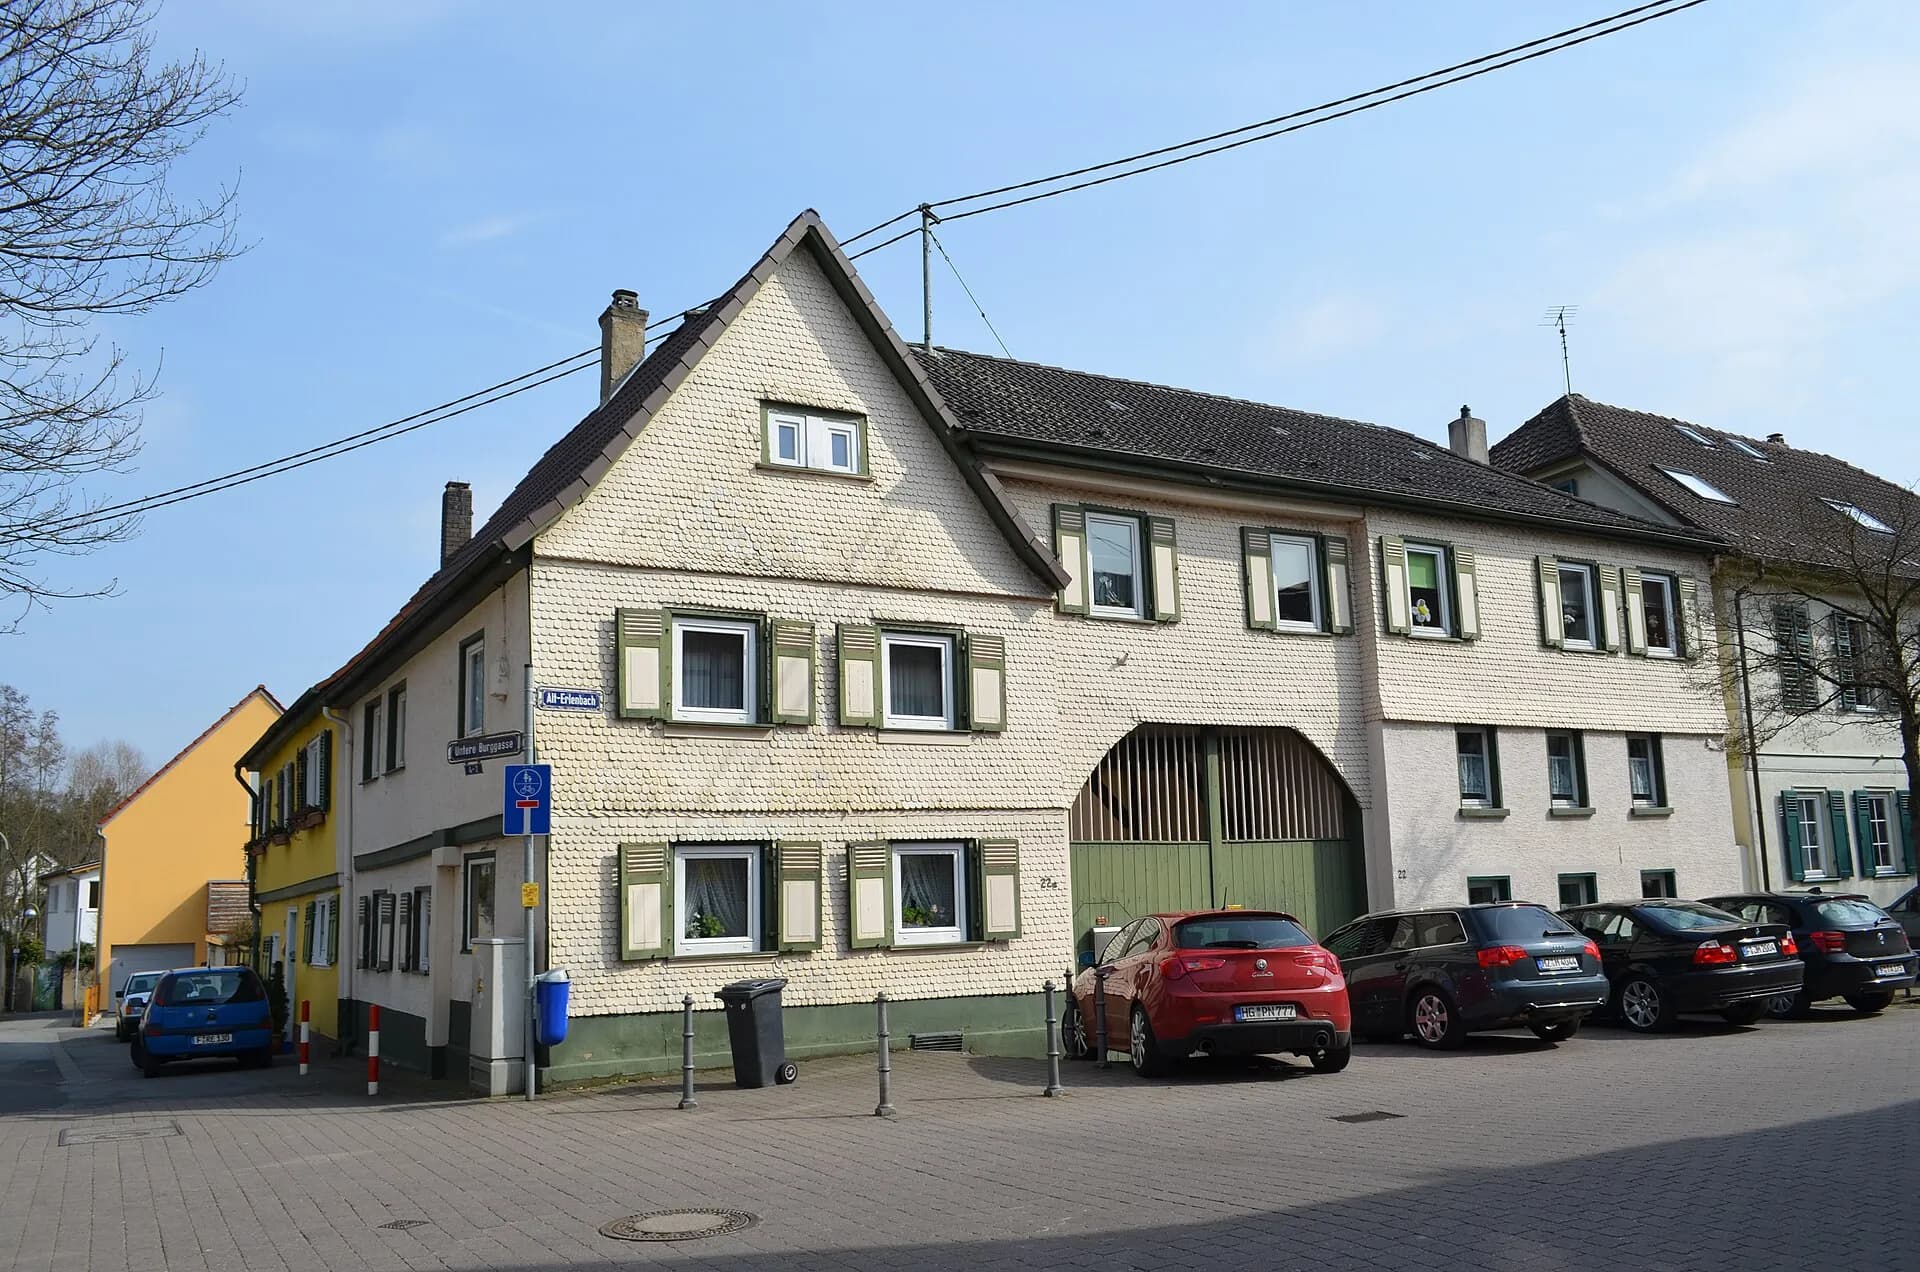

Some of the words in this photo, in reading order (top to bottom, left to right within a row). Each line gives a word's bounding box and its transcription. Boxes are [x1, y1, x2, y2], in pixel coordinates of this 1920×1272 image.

[546, 692, 596, 706] Alt-Erlenbach
[454, 745, 477, 757] Untere
[478, 740, 514, 754] Burggasse
[1241, 1007, 1255, 1018] HG
[1261, 1006, 1275, 1017] PN
[1276, 1005, 1294, 1016] 777
